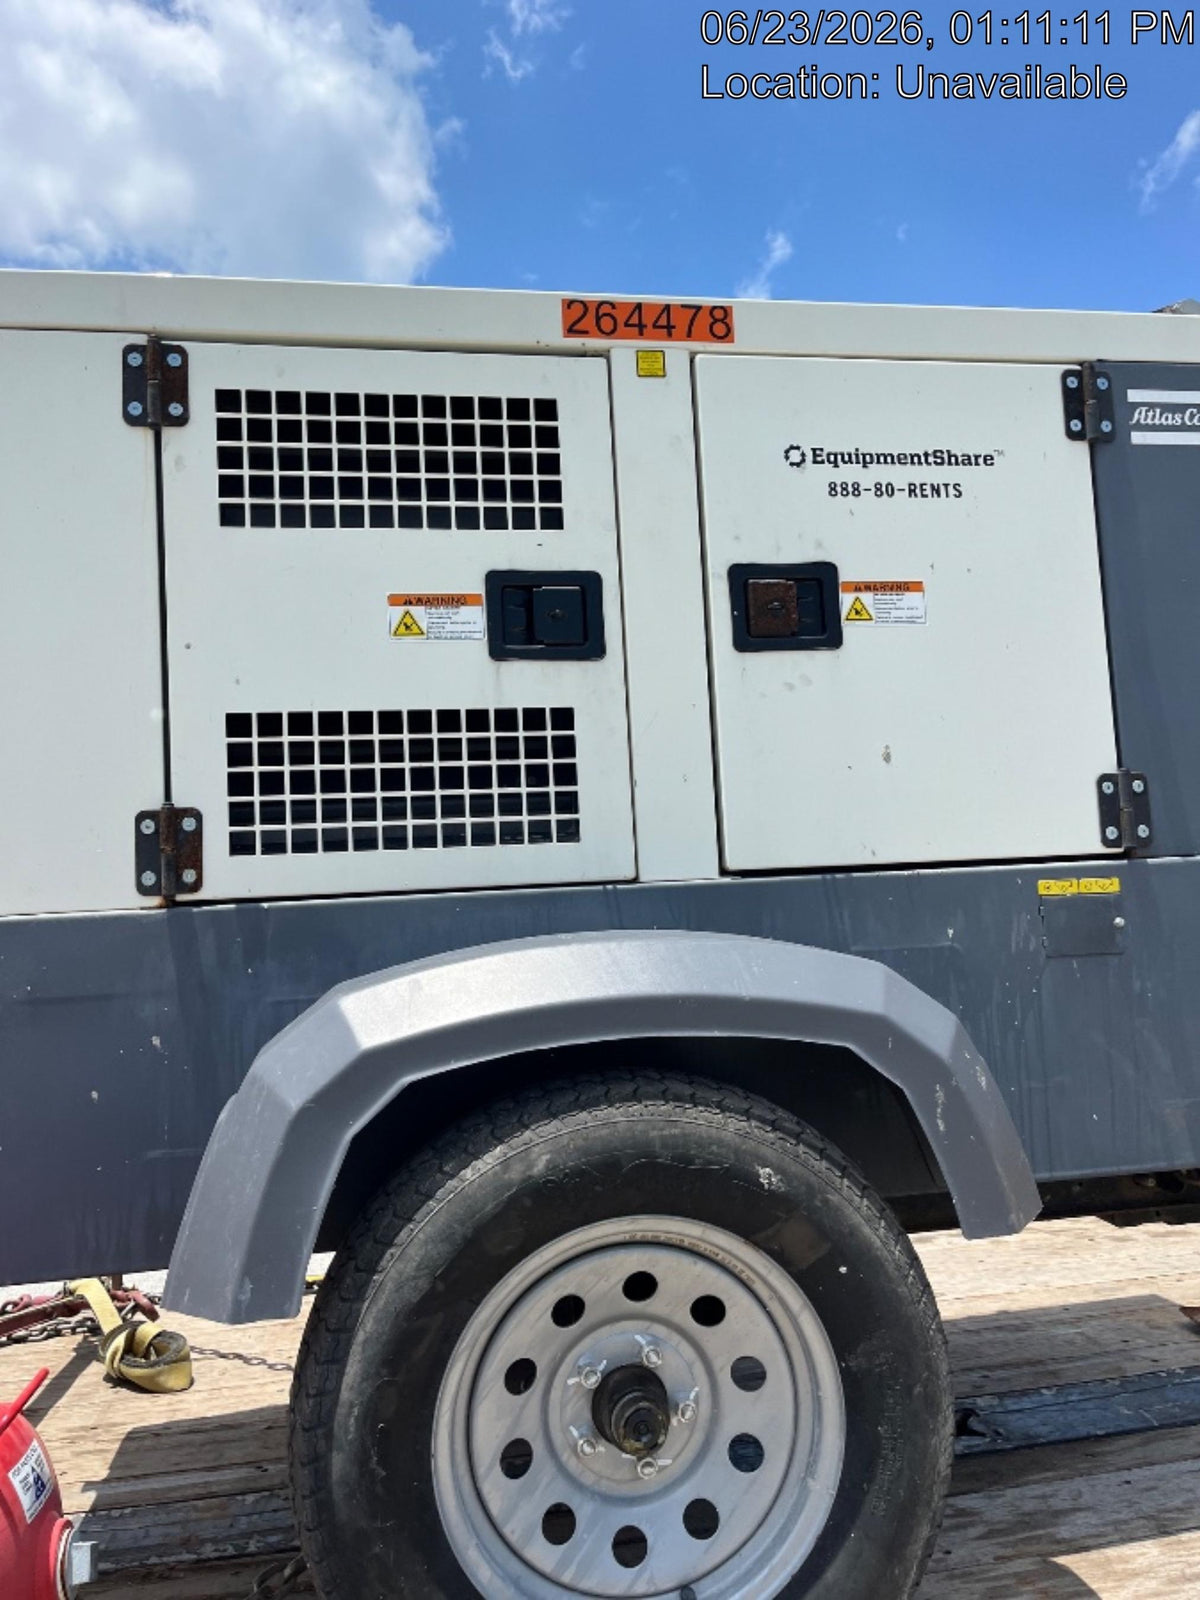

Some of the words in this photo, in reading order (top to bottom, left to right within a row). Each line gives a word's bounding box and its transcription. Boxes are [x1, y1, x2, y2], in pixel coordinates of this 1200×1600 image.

[566, 299, 732, 340] 264478
[1129, 406, 1182, 426] Atlas
[828, 481, 963, 499] 888-80-RENTS
